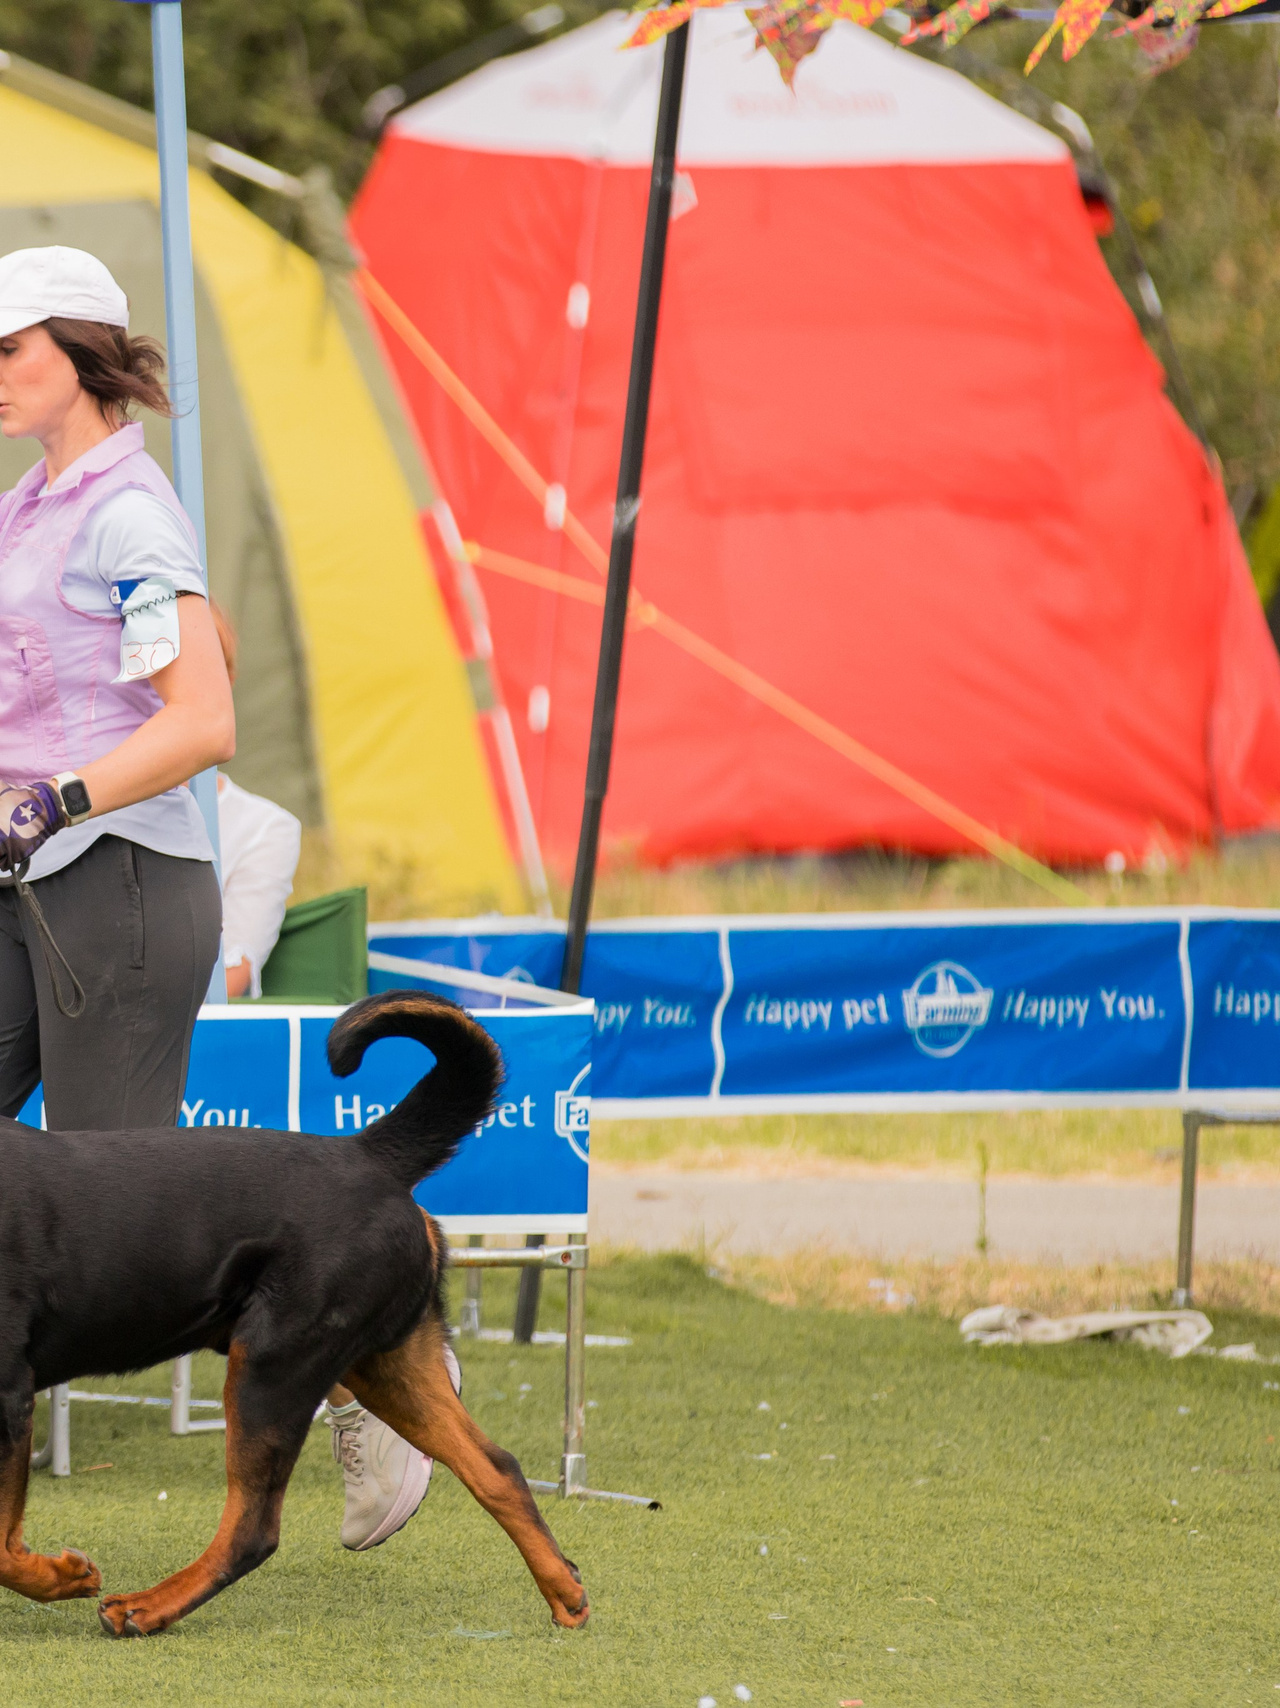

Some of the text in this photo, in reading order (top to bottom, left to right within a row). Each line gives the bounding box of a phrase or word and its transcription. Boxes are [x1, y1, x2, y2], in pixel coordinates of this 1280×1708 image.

[744, 993, 833, 1031] Happy
[1002, 988, 1165, 1029] Happy You.
[1214, 985, 1280, 1022] Hap
